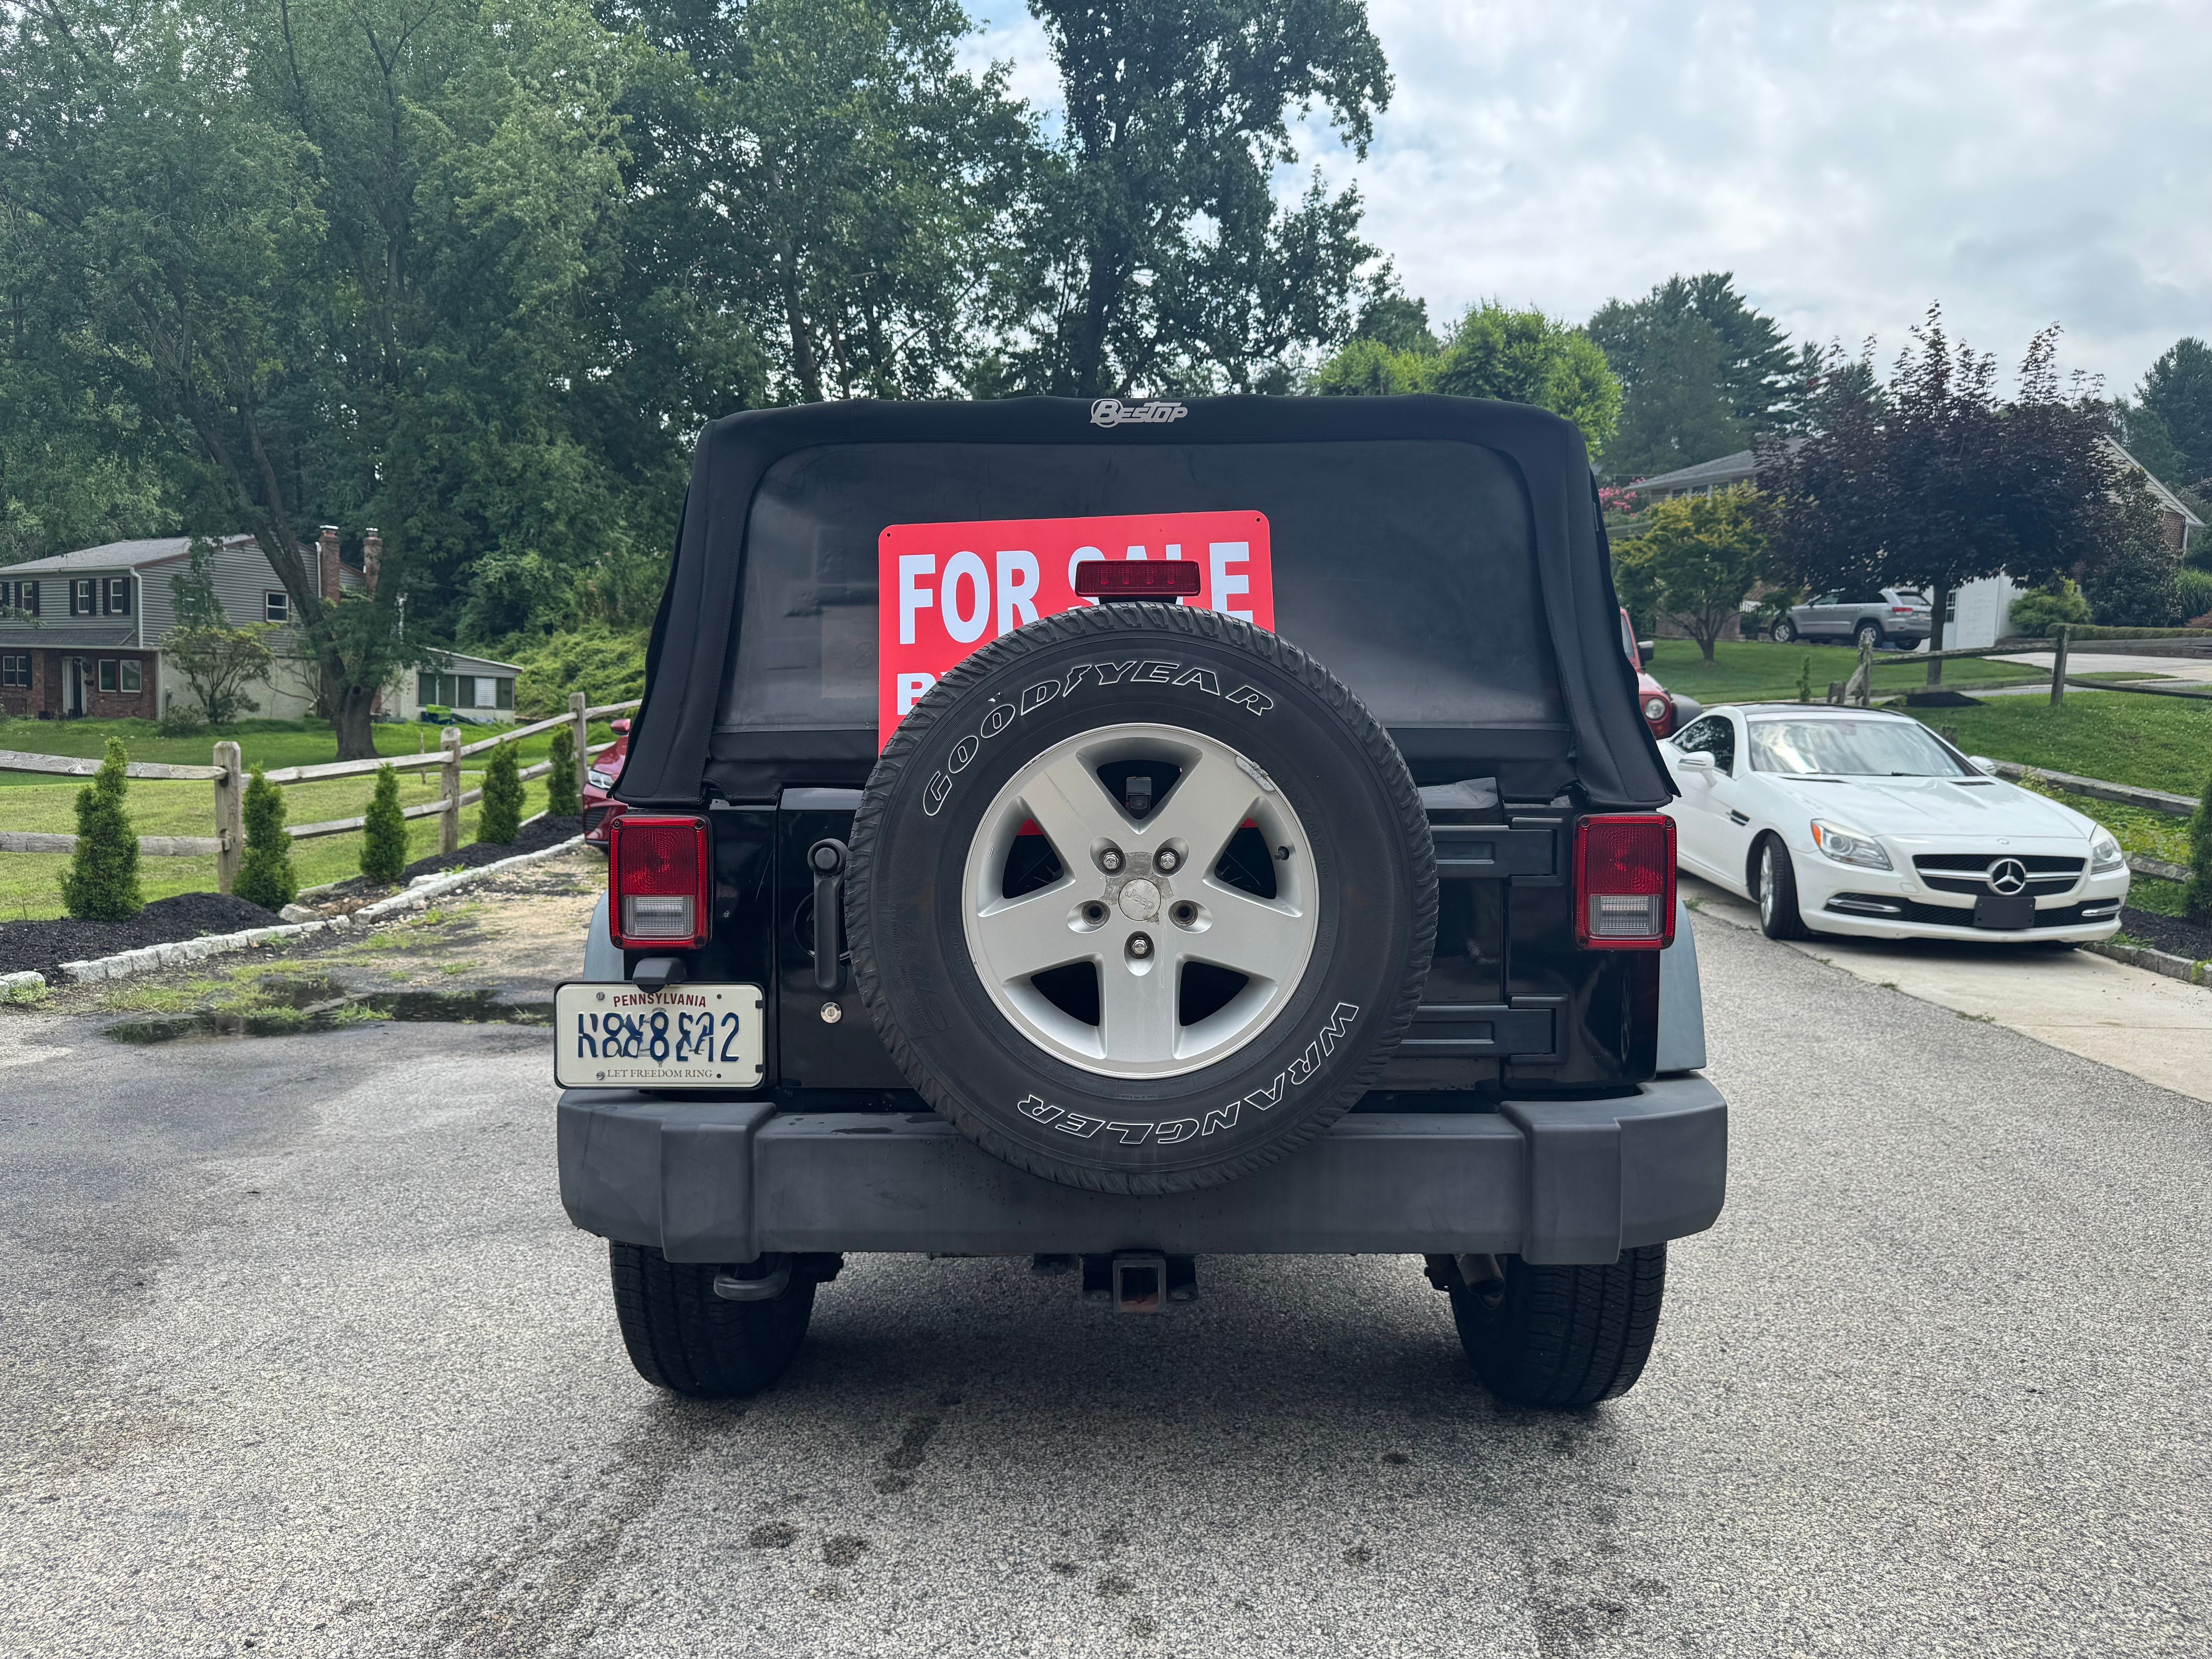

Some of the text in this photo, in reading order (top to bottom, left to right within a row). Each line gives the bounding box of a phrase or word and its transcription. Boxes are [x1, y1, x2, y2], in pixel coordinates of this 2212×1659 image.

[899, 551, 1040, 644] FOR
[923, 661, 1273, 816] GOODYEAR
[613, 993, 706, 1008] PENNSYLVANIA
[607, 1069, 713, 1078] LET FREEDOM RING
[1017, 1002, 1359, 1144] WRANGLER
